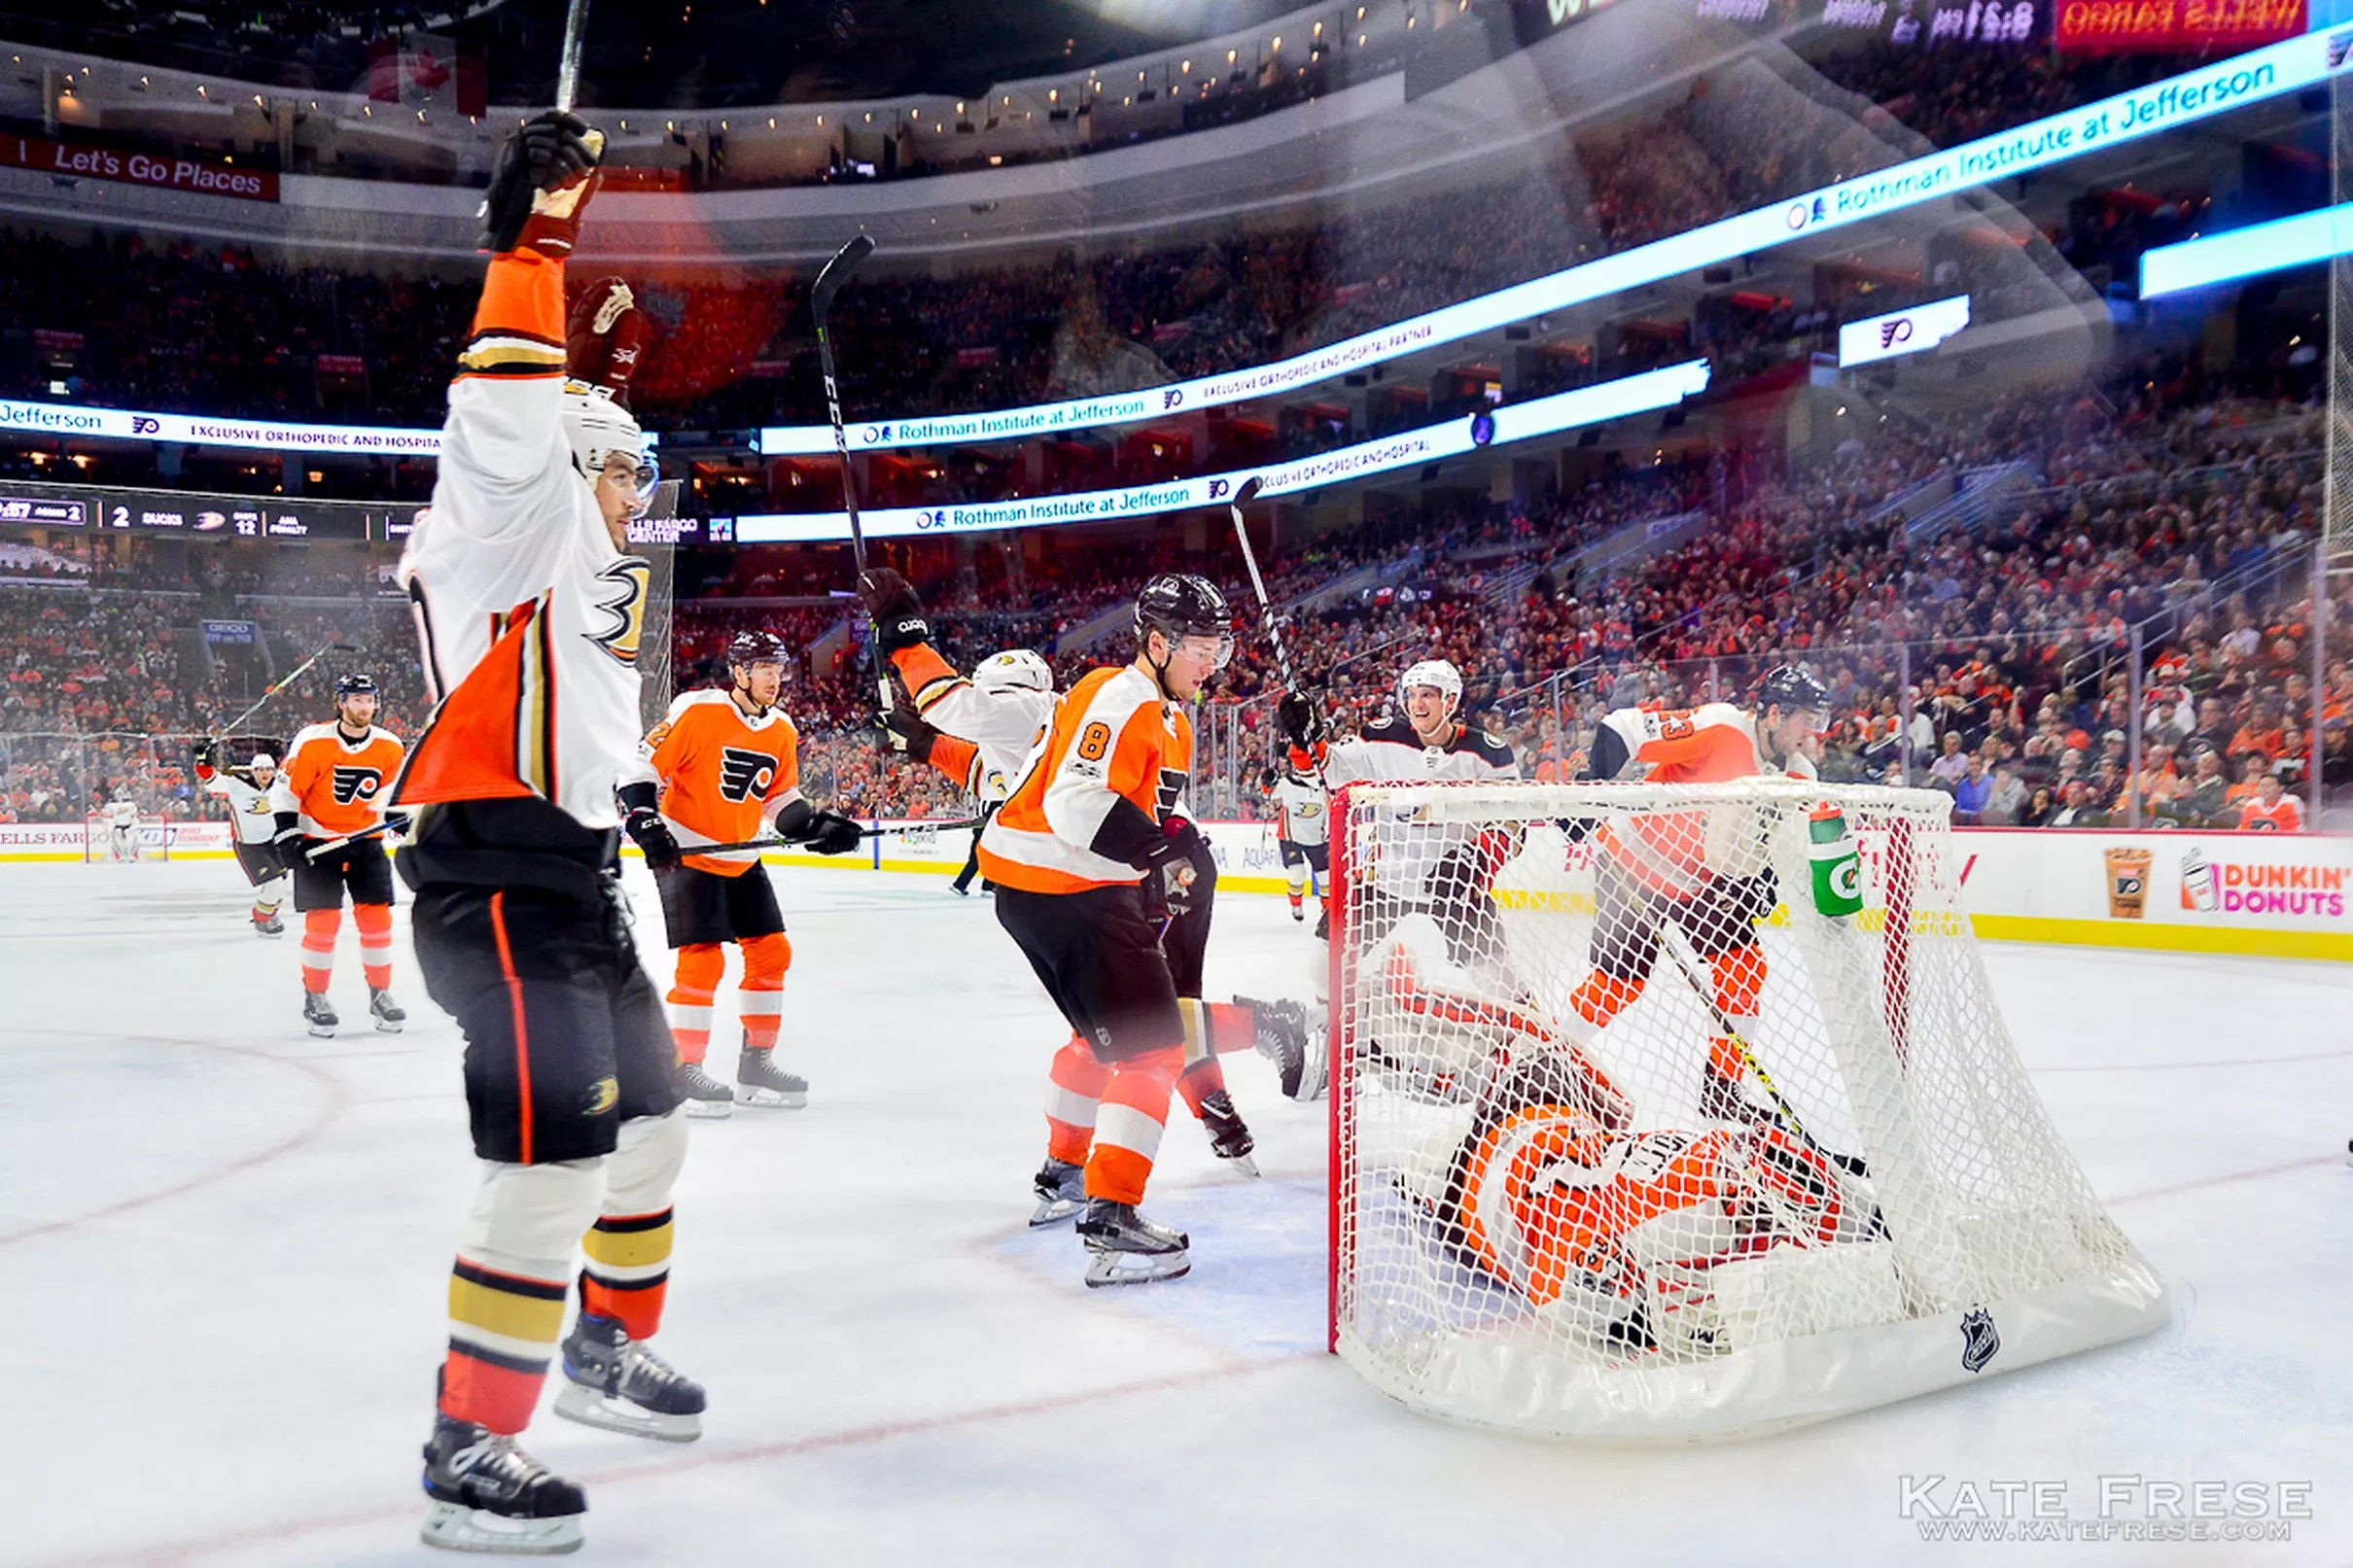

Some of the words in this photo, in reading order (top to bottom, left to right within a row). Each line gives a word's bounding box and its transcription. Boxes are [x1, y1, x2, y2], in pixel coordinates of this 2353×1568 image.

[1836, 165, 1949, 214] Rothman
[1958, 128, 2072, 177] Institute
[2082, 112, 2110, 141] at
[2120, 61, 2275, 130] Jefferson
[54, 144, 121, 176] Let's
[128, 155, 167, 183] Go
[173, 160, 262, 194] Places
[1203, 378, 1257, 399] EXCLUSIVE
[1259, 362, 1318, 388] ORTHOPEDIC
[1320, 355, 1341, 370] AND
[1342, 338, 1387, 364] HOSPITAL
[0, 403, 102, 430] Jefferson
[898, 421, 977, 439] Rothman
[981, 412, 1045, 434] Institute
[1049, 410, 1064, 425] at
[1069, 400, 1144, 422] Jefferson
[190, 425, 262, 441] EXCLUSIVE
[265, 431, 348, 446] ORTHOPEDIC
[353, 436, 382, 447] AND
[385, 436, 441, 449] HOSPITA
[1261, 469, 1302, 488] CLUSIVE
[1303, 457, 1361, 481] ORTHOPEDIC
[1362, 451, 1383, 466] AND
[1384, 439, 1431, 461] HOSPITAL
[68, 505, 81, 521] 2
[112, 505, 130, 527] 2
[141, 512, 183, 526] DUCKS
[953, 506, 1026, 526] Rothman
[1031, 499, 1095, 518] Institute
[1100, 497, 1114, 511] at
[1119, 488, 1189, 510] Jefferson
[235, 520, 256, 535] 12
[1077, 721, 1111, 762] 8
[0, 832, 46, 845] ELLS
[2224, 863, 2351, 890] DUNKIN'
[2224, 889, 2345, 918] DONUTS
